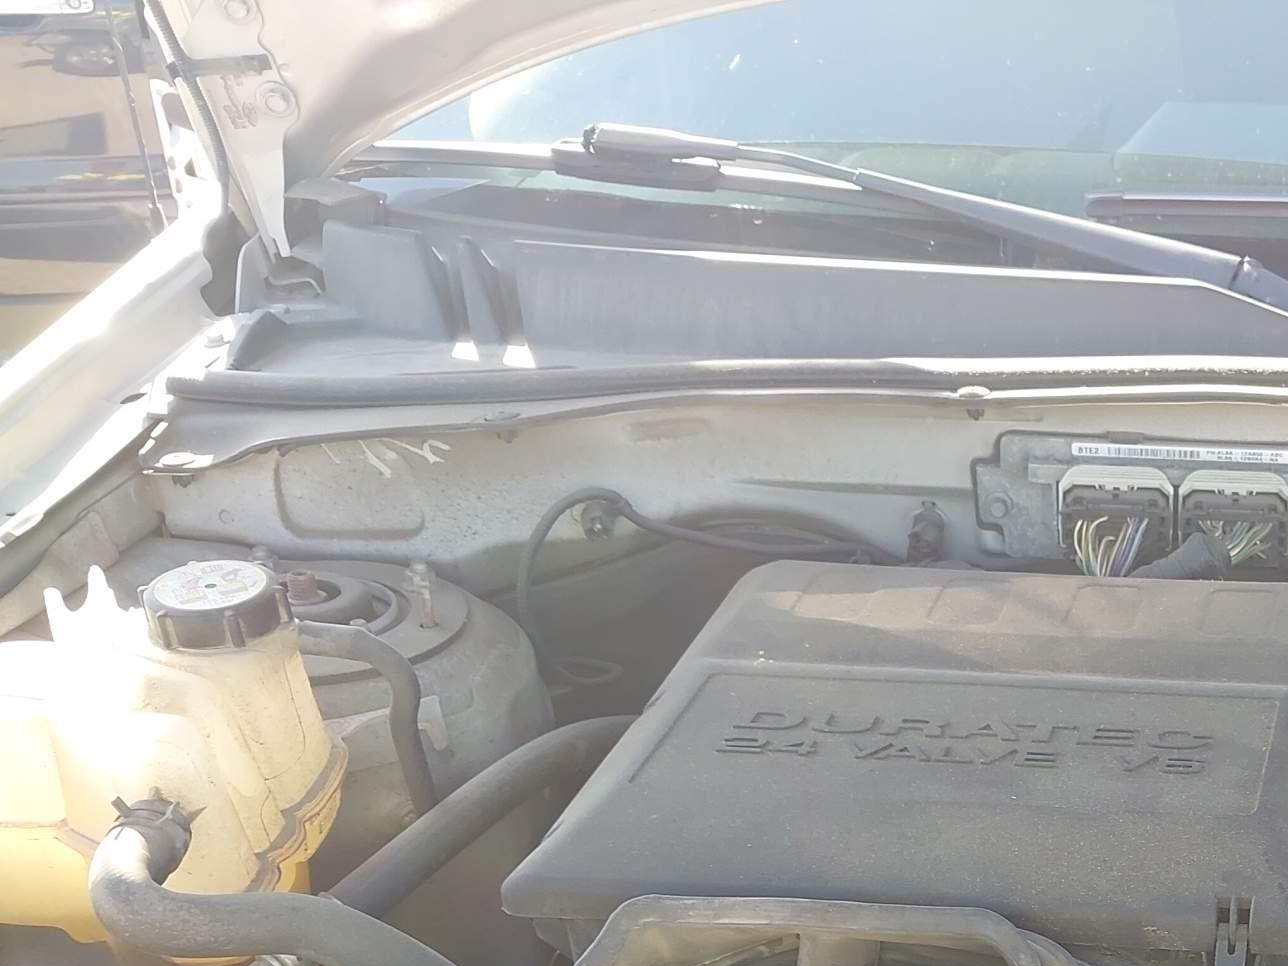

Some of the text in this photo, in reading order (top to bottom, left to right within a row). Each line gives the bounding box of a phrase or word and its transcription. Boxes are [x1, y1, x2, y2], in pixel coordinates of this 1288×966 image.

[732, 711, 1214, 750] DURATEC
[715, 737, 819, 757] 24
[853, 742, 1060, 769] VALVE
